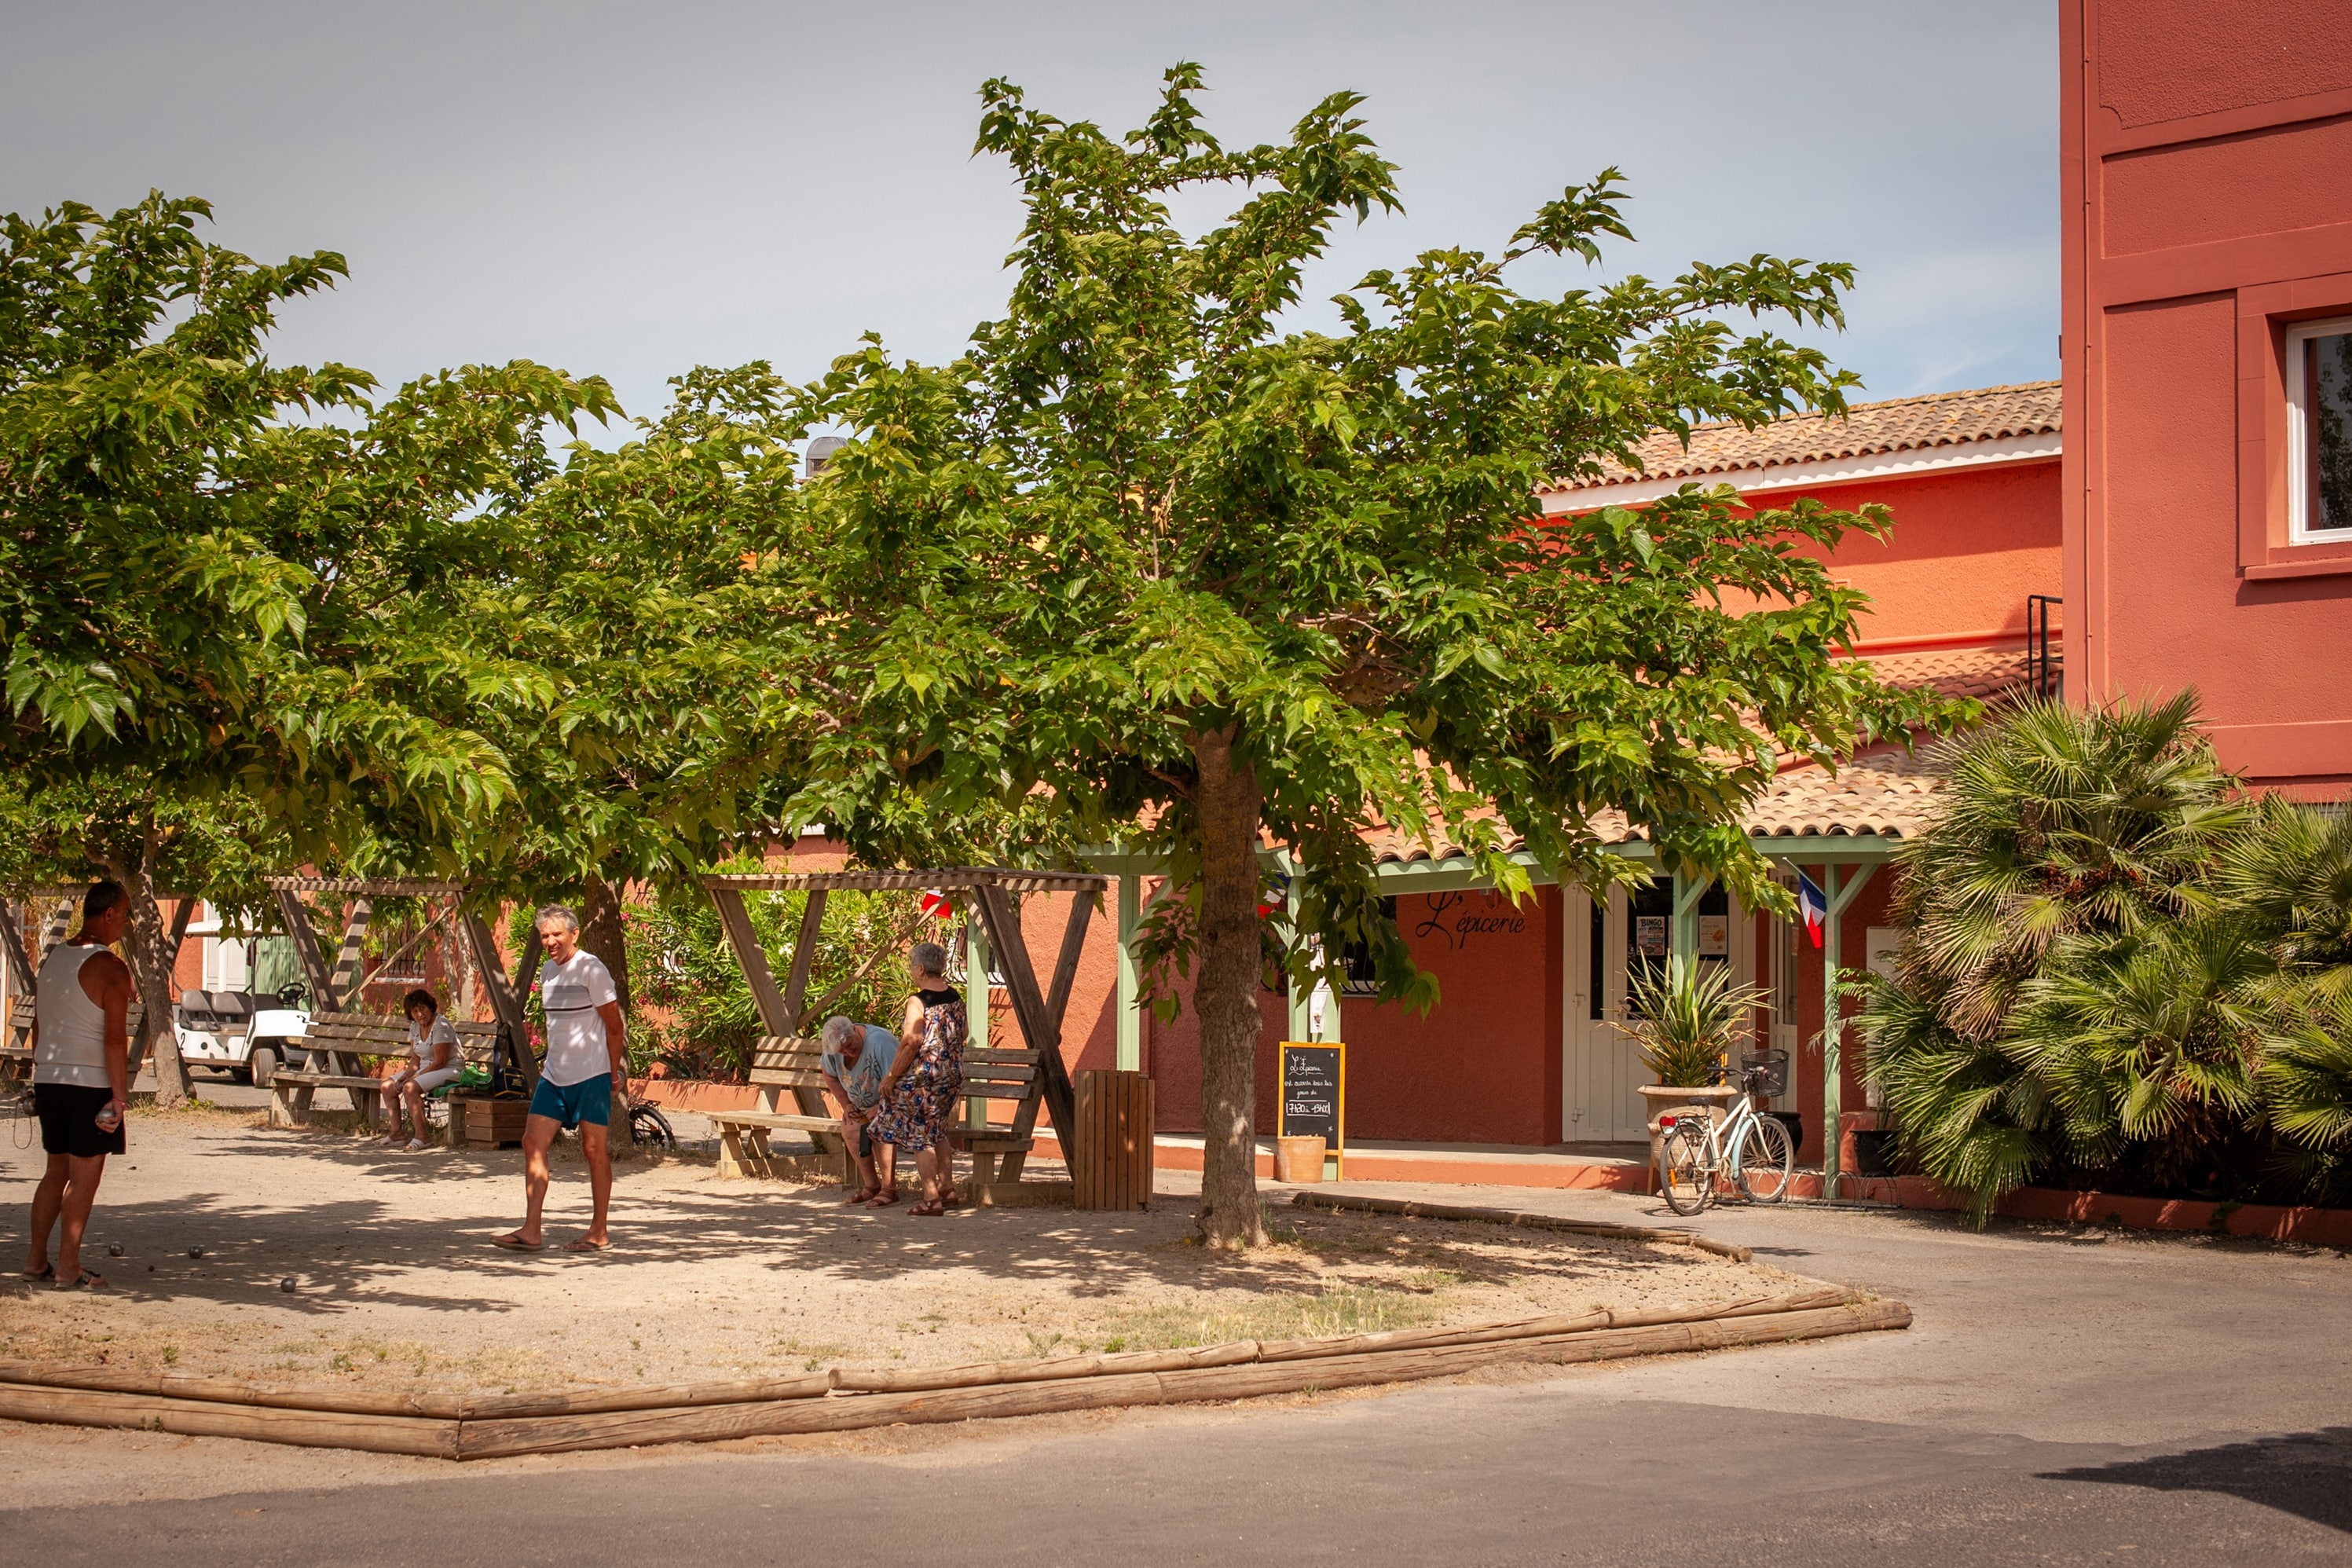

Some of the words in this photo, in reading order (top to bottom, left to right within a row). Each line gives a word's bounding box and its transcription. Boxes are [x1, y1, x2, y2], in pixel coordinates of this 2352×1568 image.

[1416, 891, 1526, 950] L'épicerie
[1641, 918, 1662, 927] BINGO
[180, 1032, 185, 1050] 2
[1288, 1103, 1306, 1113] 7h30
